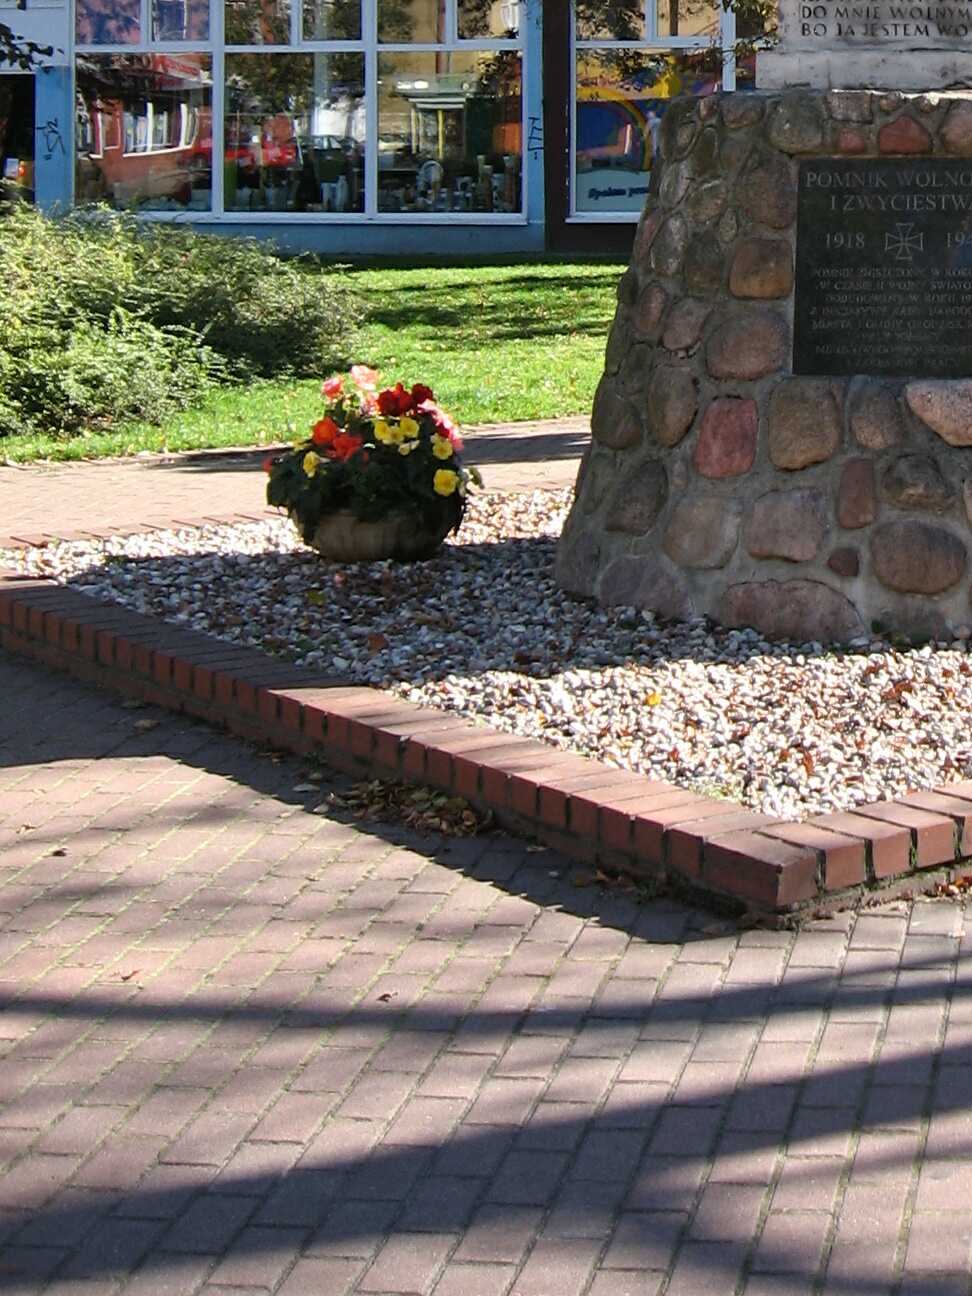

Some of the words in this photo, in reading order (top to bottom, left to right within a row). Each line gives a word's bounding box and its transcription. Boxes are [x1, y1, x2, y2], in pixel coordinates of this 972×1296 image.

[802, 5, 828, 19] DO
[834, 6, 880, 20] MNIE
[889, 6, 970, 21] WOLNYM
[801, 22, 828, 37] BO
[836, 22, 855, 37] JA
[863, 23, 930, 38] JESTEM
[806, 170, 888, 188] POMNIK
[825, 231, 866, 249] 1918
